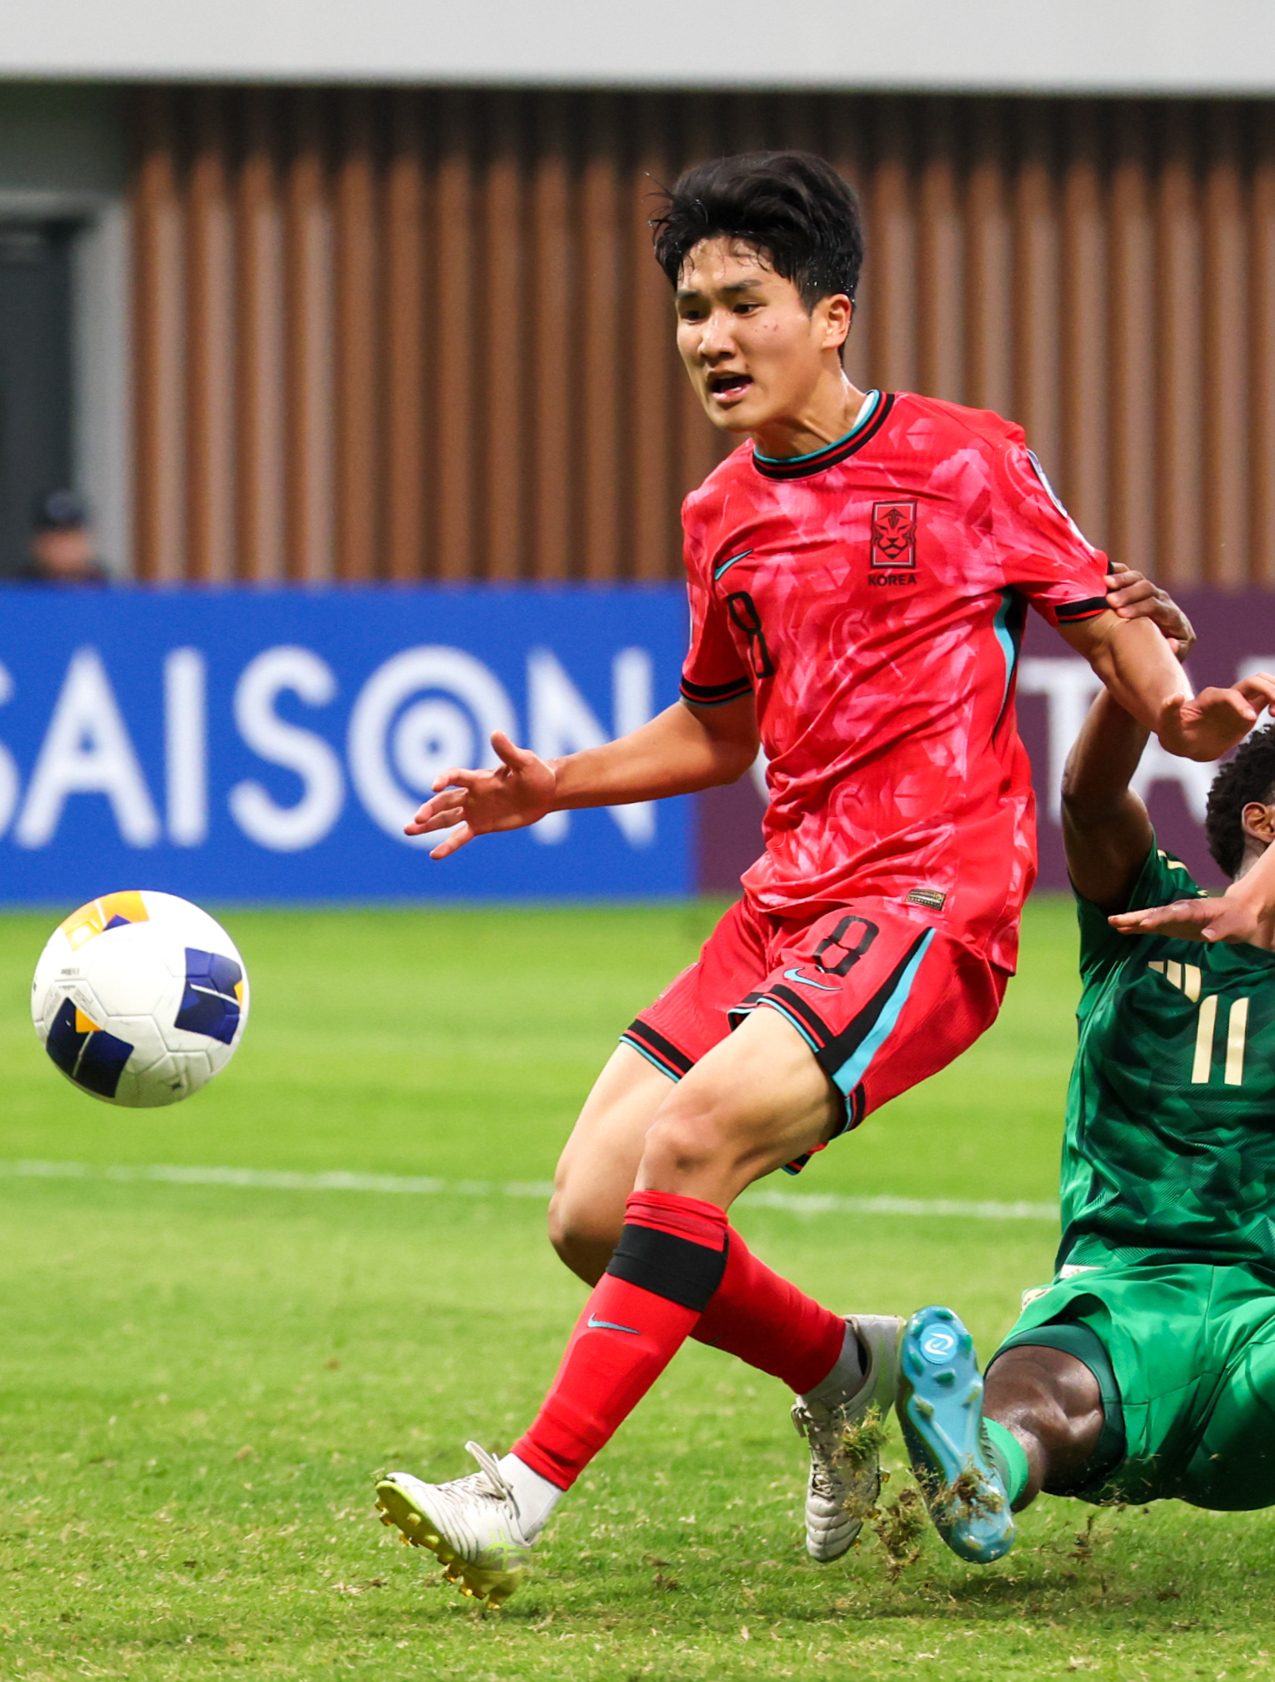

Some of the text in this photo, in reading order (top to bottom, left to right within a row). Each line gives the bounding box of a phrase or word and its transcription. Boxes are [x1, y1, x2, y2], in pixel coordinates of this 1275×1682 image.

[867, 574, 918, 587] KOREA
[726, 591, 775, 679] 8
[0, 645, 655, 852] AISON
[813, 915, 880, 977] 8
[1190, 994, 1250, 1087] 11
